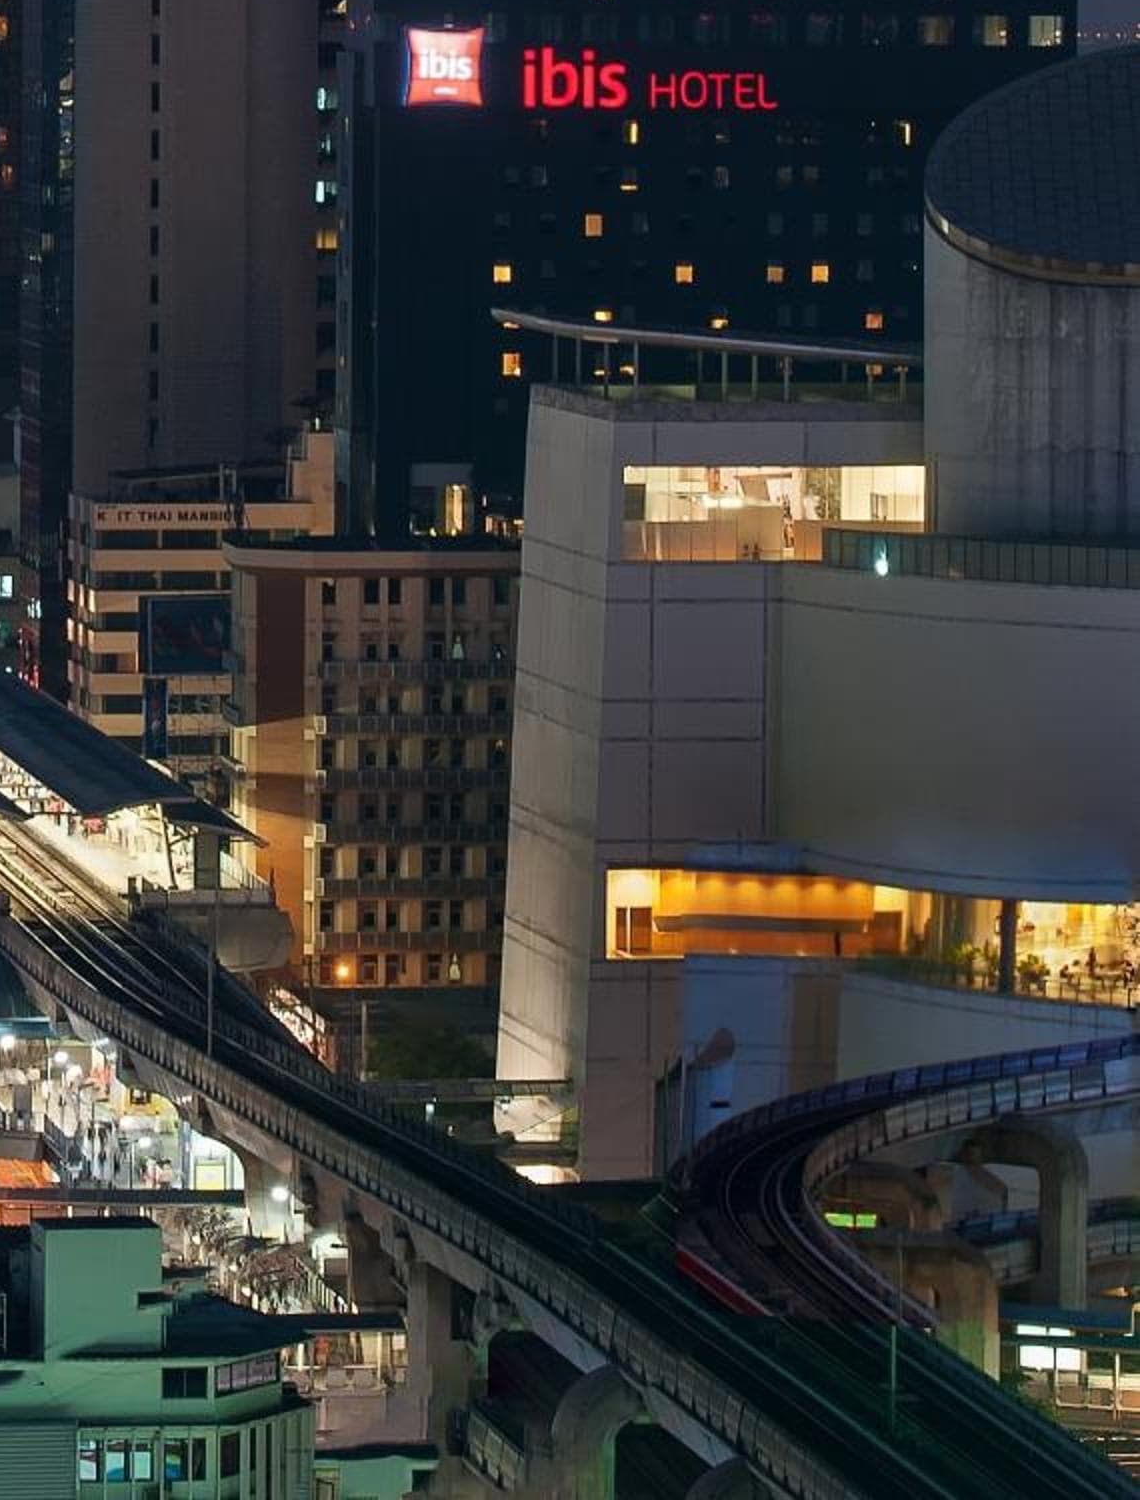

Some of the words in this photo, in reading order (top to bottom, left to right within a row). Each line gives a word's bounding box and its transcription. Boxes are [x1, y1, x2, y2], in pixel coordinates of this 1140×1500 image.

[419, 50, 473, 80] ibis
[522, 46, 628, 109] ibis
[650, 71, 779, 110] HOTEL
[139, 511, 172, 522] THAI
